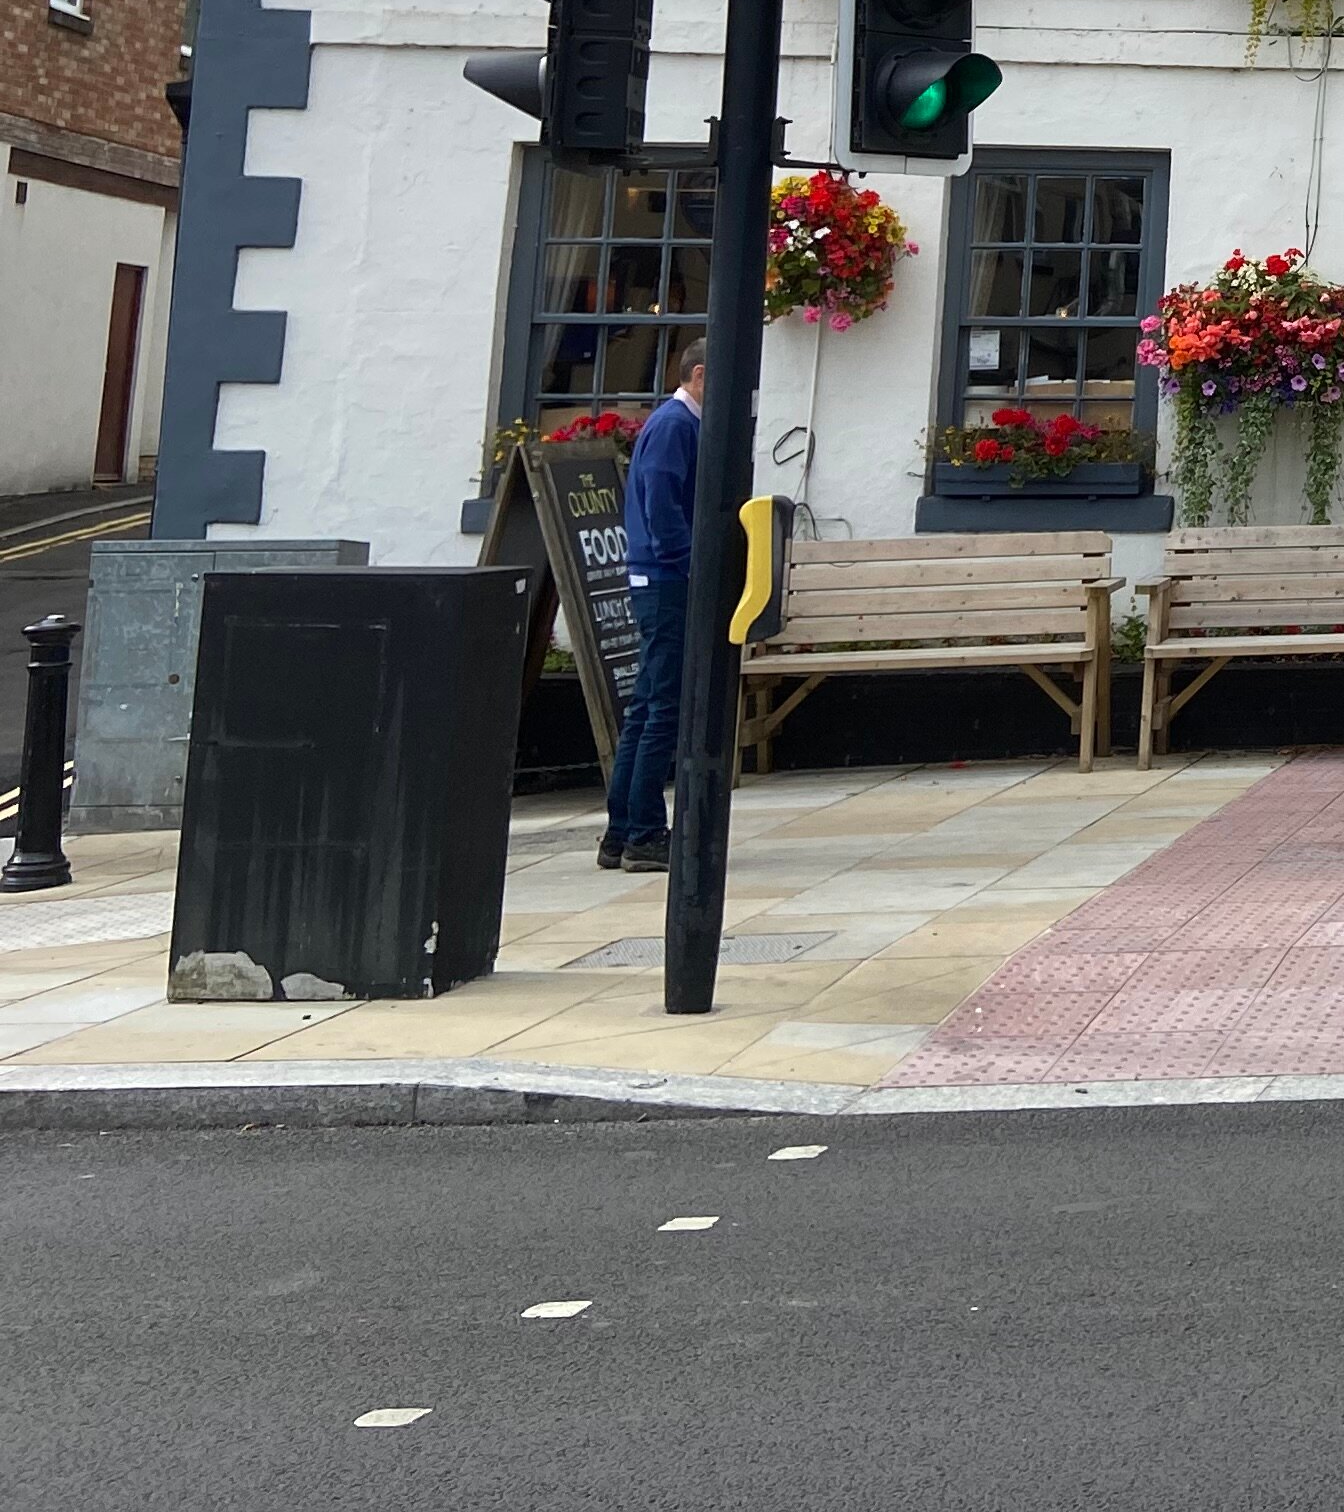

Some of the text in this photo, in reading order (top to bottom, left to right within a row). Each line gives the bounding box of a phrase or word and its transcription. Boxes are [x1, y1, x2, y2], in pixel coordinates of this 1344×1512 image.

[578, 473, 595, 488] THE
[567, 487, 619, 518] COUNTY
[579, 525, 628, 567] FOOD
[592, 601, 624, 622] LUNCH
